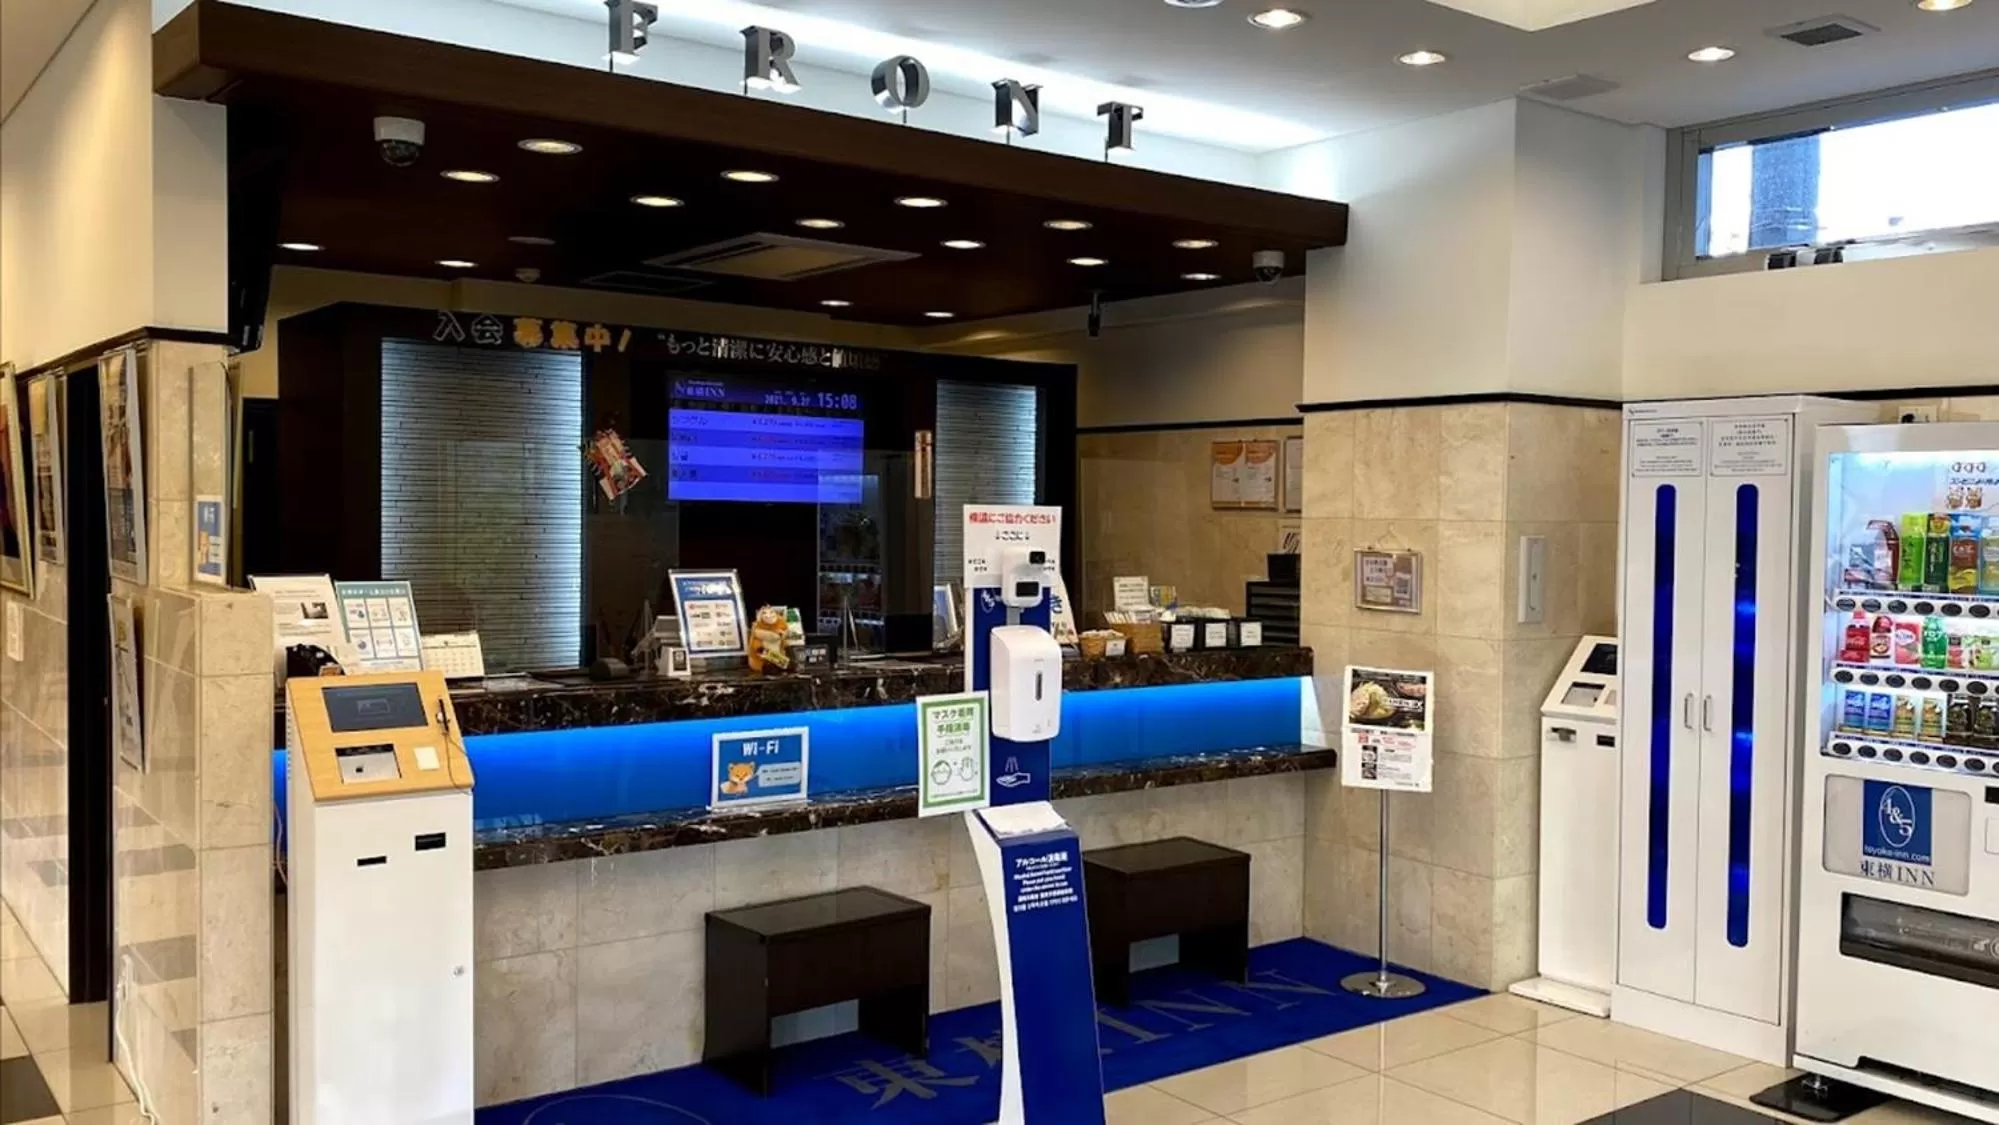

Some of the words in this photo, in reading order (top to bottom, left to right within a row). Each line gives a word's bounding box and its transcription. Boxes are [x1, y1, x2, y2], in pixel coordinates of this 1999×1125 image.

[608, 0, 1144, 149] FRONT
[817, 391, 858, 409] 15:08
[743, 740, 779, 757] Wi-Fi
[1864, 844, 1930, 862] toyoko-inn.com
